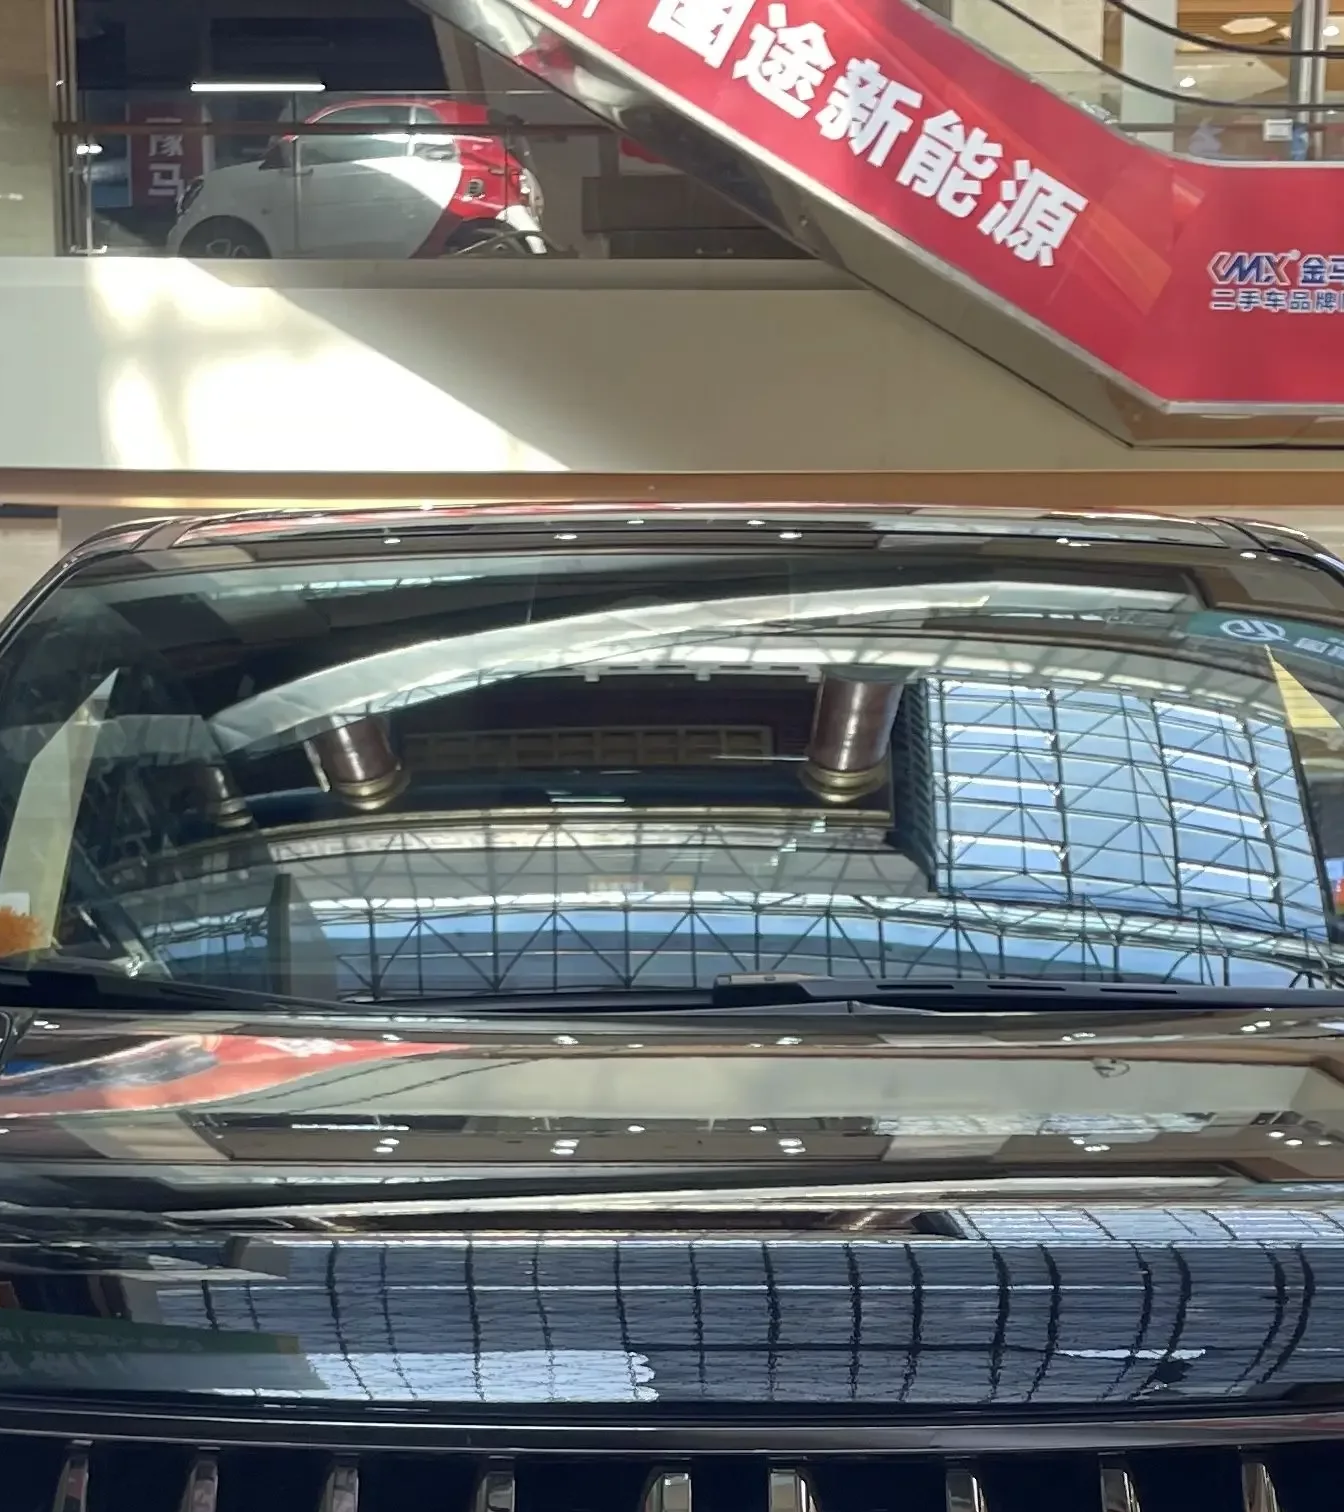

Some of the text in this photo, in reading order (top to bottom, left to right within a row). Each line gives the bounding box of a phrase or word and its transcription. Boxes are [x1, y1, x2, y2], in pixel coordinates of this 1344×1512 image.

[562, 0, 1090, 268] 图途新能源
